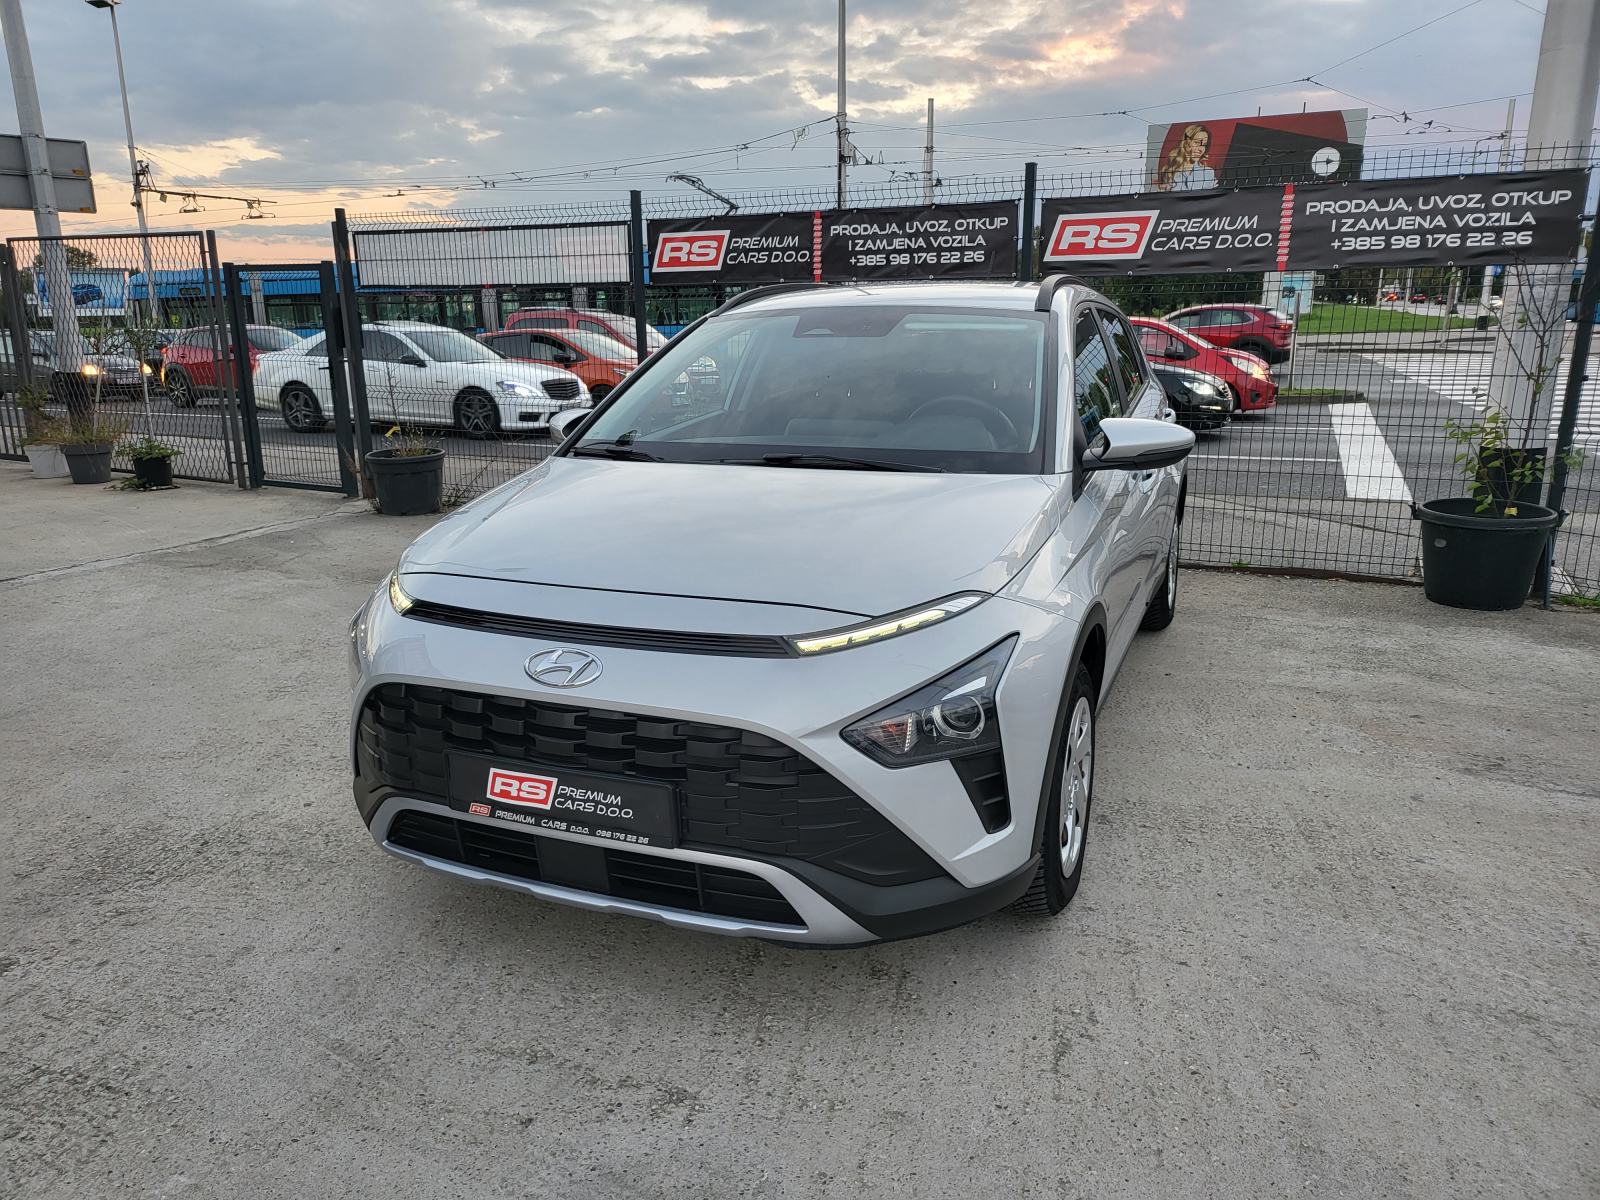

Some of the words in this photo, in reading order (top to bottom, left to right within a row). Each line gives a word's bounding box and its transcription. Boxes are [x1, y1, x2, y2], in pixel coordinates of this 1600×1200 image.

[1306, 197, 1413, 215] PRODAJA,
[1419, 194, 1486, 210] UVOZ,
[1492, 190, 1572, 206] OTKUP
[831, 222, 905, 237] PRODAJA,
[906, 220, 951, 233] UVOZ,
[955, 217, 1009, 231] OTKUP
[1157, 215, 1259, 234] PREMIUM
[1331, 219, 1337, 233] I
[1341, 215, 1447, 232] ZAMJENA
[1454, 212, 1537, 228] VOZILA
[730, 236, 799, 250] PREMIUM
[855, 238, 927, 251] ZAMJENA
[930, 235, 986, 248] VOZILA
[1059, 223, 1141, 250] RS
[1152, 236, 1213, 251] CARS
[1214, 232, 1274, 249] D.O.O.
[1330, 236, 1386, 250] +385
[1391, 235, 1421, 249] 98
[1426, 234, 1462, 248] 176
[1467, 232, 1496, 247] 22
[1501, 231, 1533, 246] 26
[662, 240, 718, 263] RS
[727, 252, 769, 264] CARS
[771, 250, 812, 263] D.O.O.
[849, 255, 886, 266] +385
[889, 254, 911, 265] 98
[914, 253, 938, 264] 176
[941, 252, 961, 263] 22
[964, 251, 985, 263] 26
[493, 776, 548, 800] RS
[557, 786, 621, 806] PREMIUM
[471, 805, 489, 814] RS
[555, 798, 596, 813] CARS
[597, 804, 634, 819] D.O.O.
[495, 810, 535, 825] PREMIUM
[541, 819, 568, 831] CARS
[570, 825, 590, 835] D.O.O.
[595, 829, 612, 838] 098
[613, 832, 626, 840] 176
[626, 834, 637, 842] 22
[638, 836, 649, 844] 26
